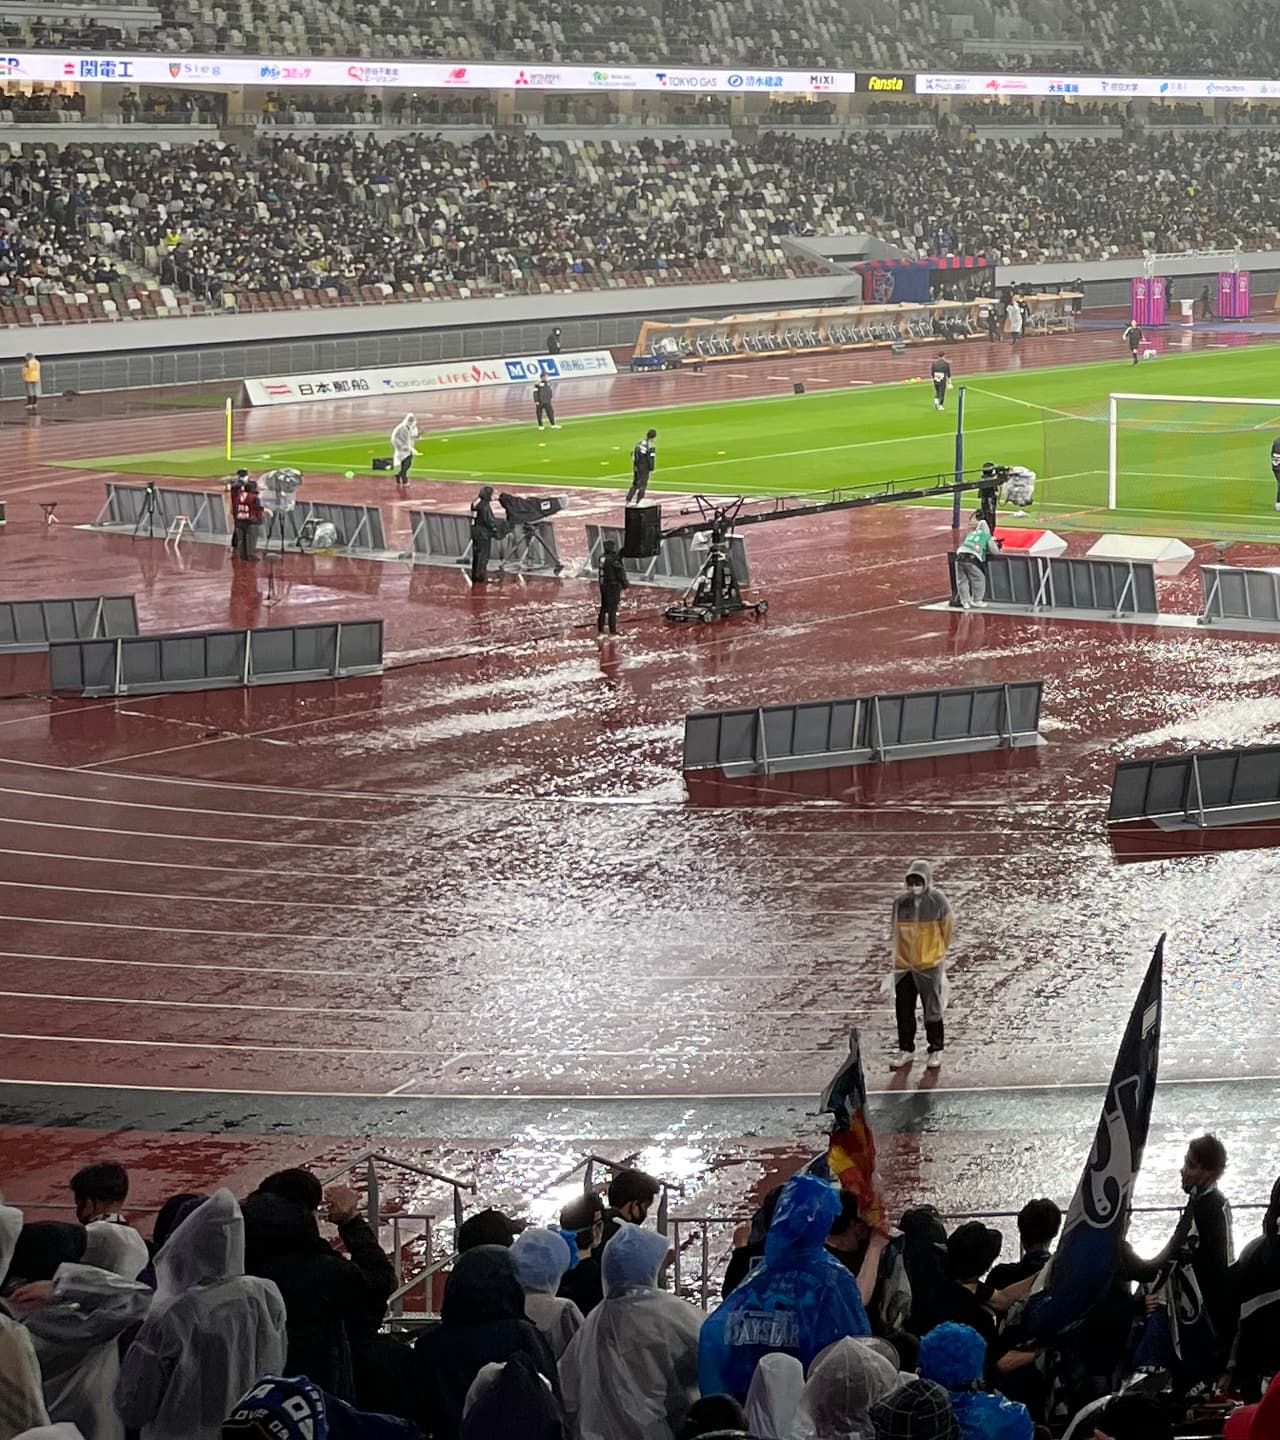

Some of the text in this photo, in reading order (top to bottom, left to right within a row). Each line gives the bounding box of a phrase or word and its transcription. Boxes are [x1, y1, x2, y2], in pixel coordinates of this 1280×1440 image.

[80, 60, 133, 77] 関電工
[669, 77, 717, 87] TOKYO GAS
[507, 360, 557, 379] MOL
[560, 356, 609, 372] 商船三井
[299, 379, 370, 396] 日本郵船
